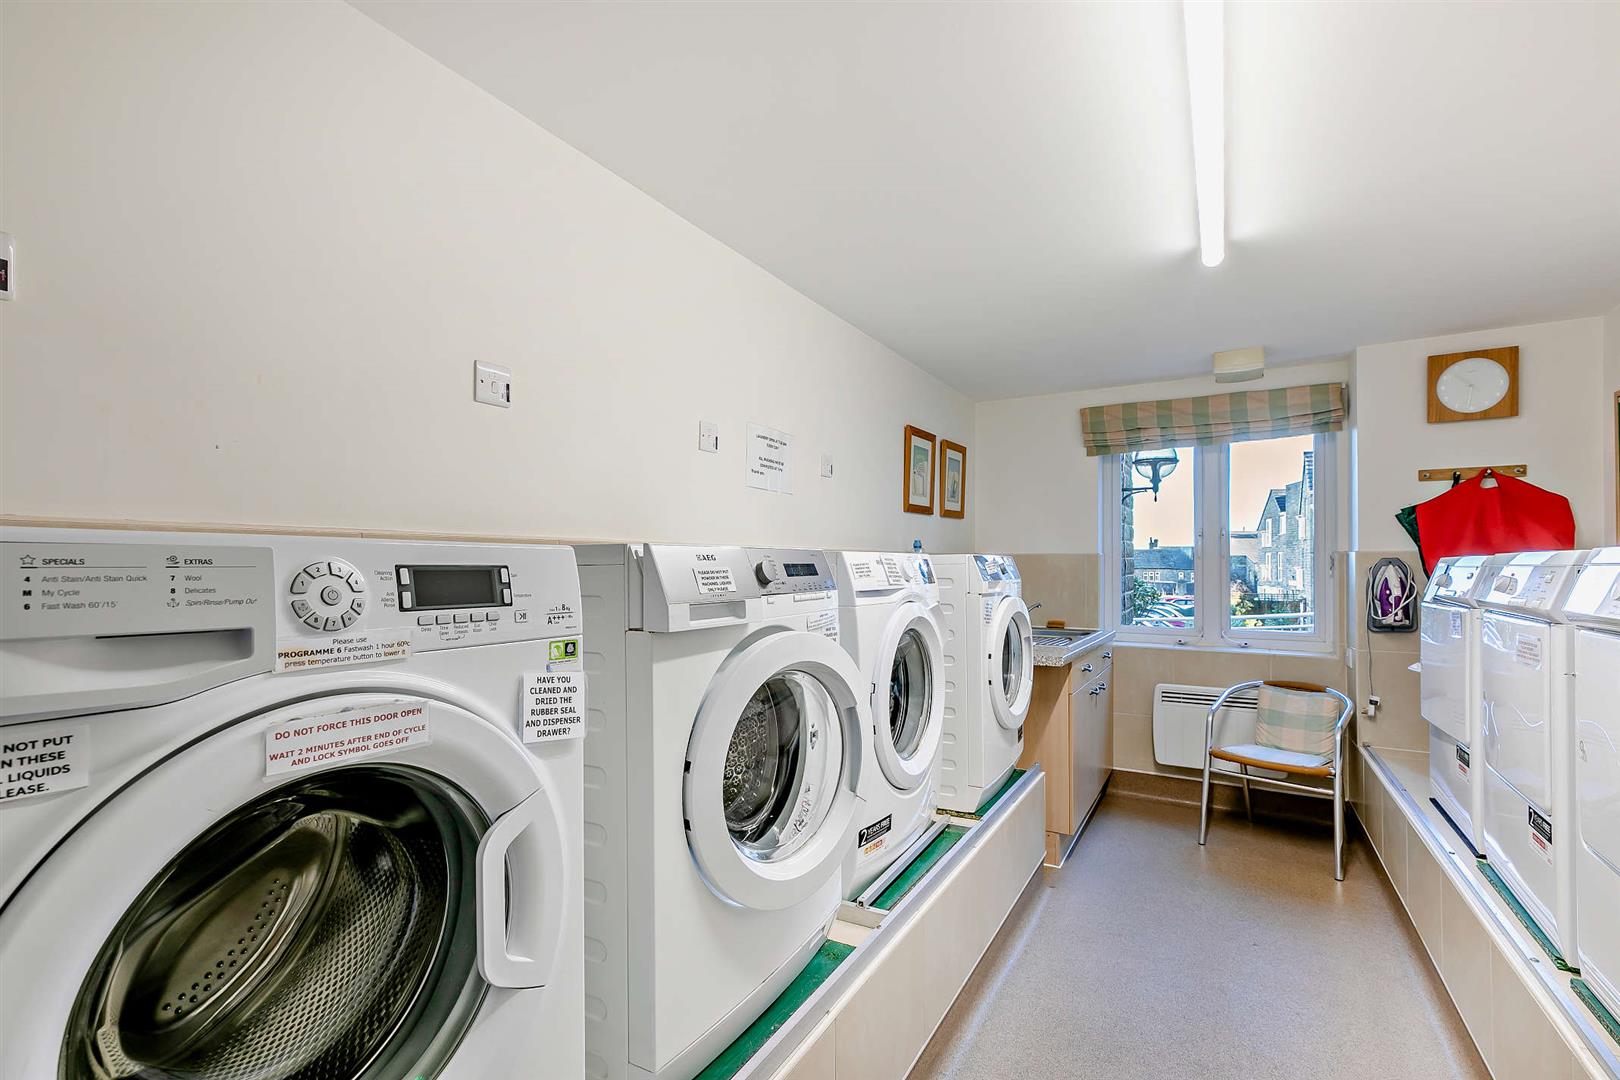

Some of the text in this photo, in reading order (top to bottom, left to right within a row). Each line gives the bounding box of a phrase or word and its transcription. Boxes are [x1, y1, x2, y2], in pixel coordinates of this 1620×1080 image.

[41, 589, 54, 597] My
[57, 589, 80, 597] Cycle
[278, 648, 334, 659] PROGRAMME
[344, 644, 374, 652] Fastwash
[284, 661, 306, 669] press
[308, 656, 351, 666] temperature
[353, 652, 374, 660] button
[536, 676, 555, 684] HAVE
[530, 686, 561, 695] CLEANED
[535, 697, 558, 705] DRIED
[531, 708, 559, 716] RUBBER
[275, 708, 422, 741] DO NOT FORCE THIS DOOR OPEN
[525, 716, 581, 728] AND DISPENSER
[537, 727, 571, 738] DRAWER?
[3, 735, 74, 754] NOT PUT
[269, 750, 295, 761] WAIT
[306, 741, 345, 754] MINUTES
[347, 735, 372, 746] AFTER
[374, 731, 390, 740] END
[392, 729, 402, 737] OF
[404, 724, 426, 734] CYCLE
[0, 750, 66, 769] N THESE
[291, 736, 410, 767] AND LOCK SYMBOL GOES OFF
[8, 764, 71, 783] LIQUIDS
[860, 829, 868, 846] 2
